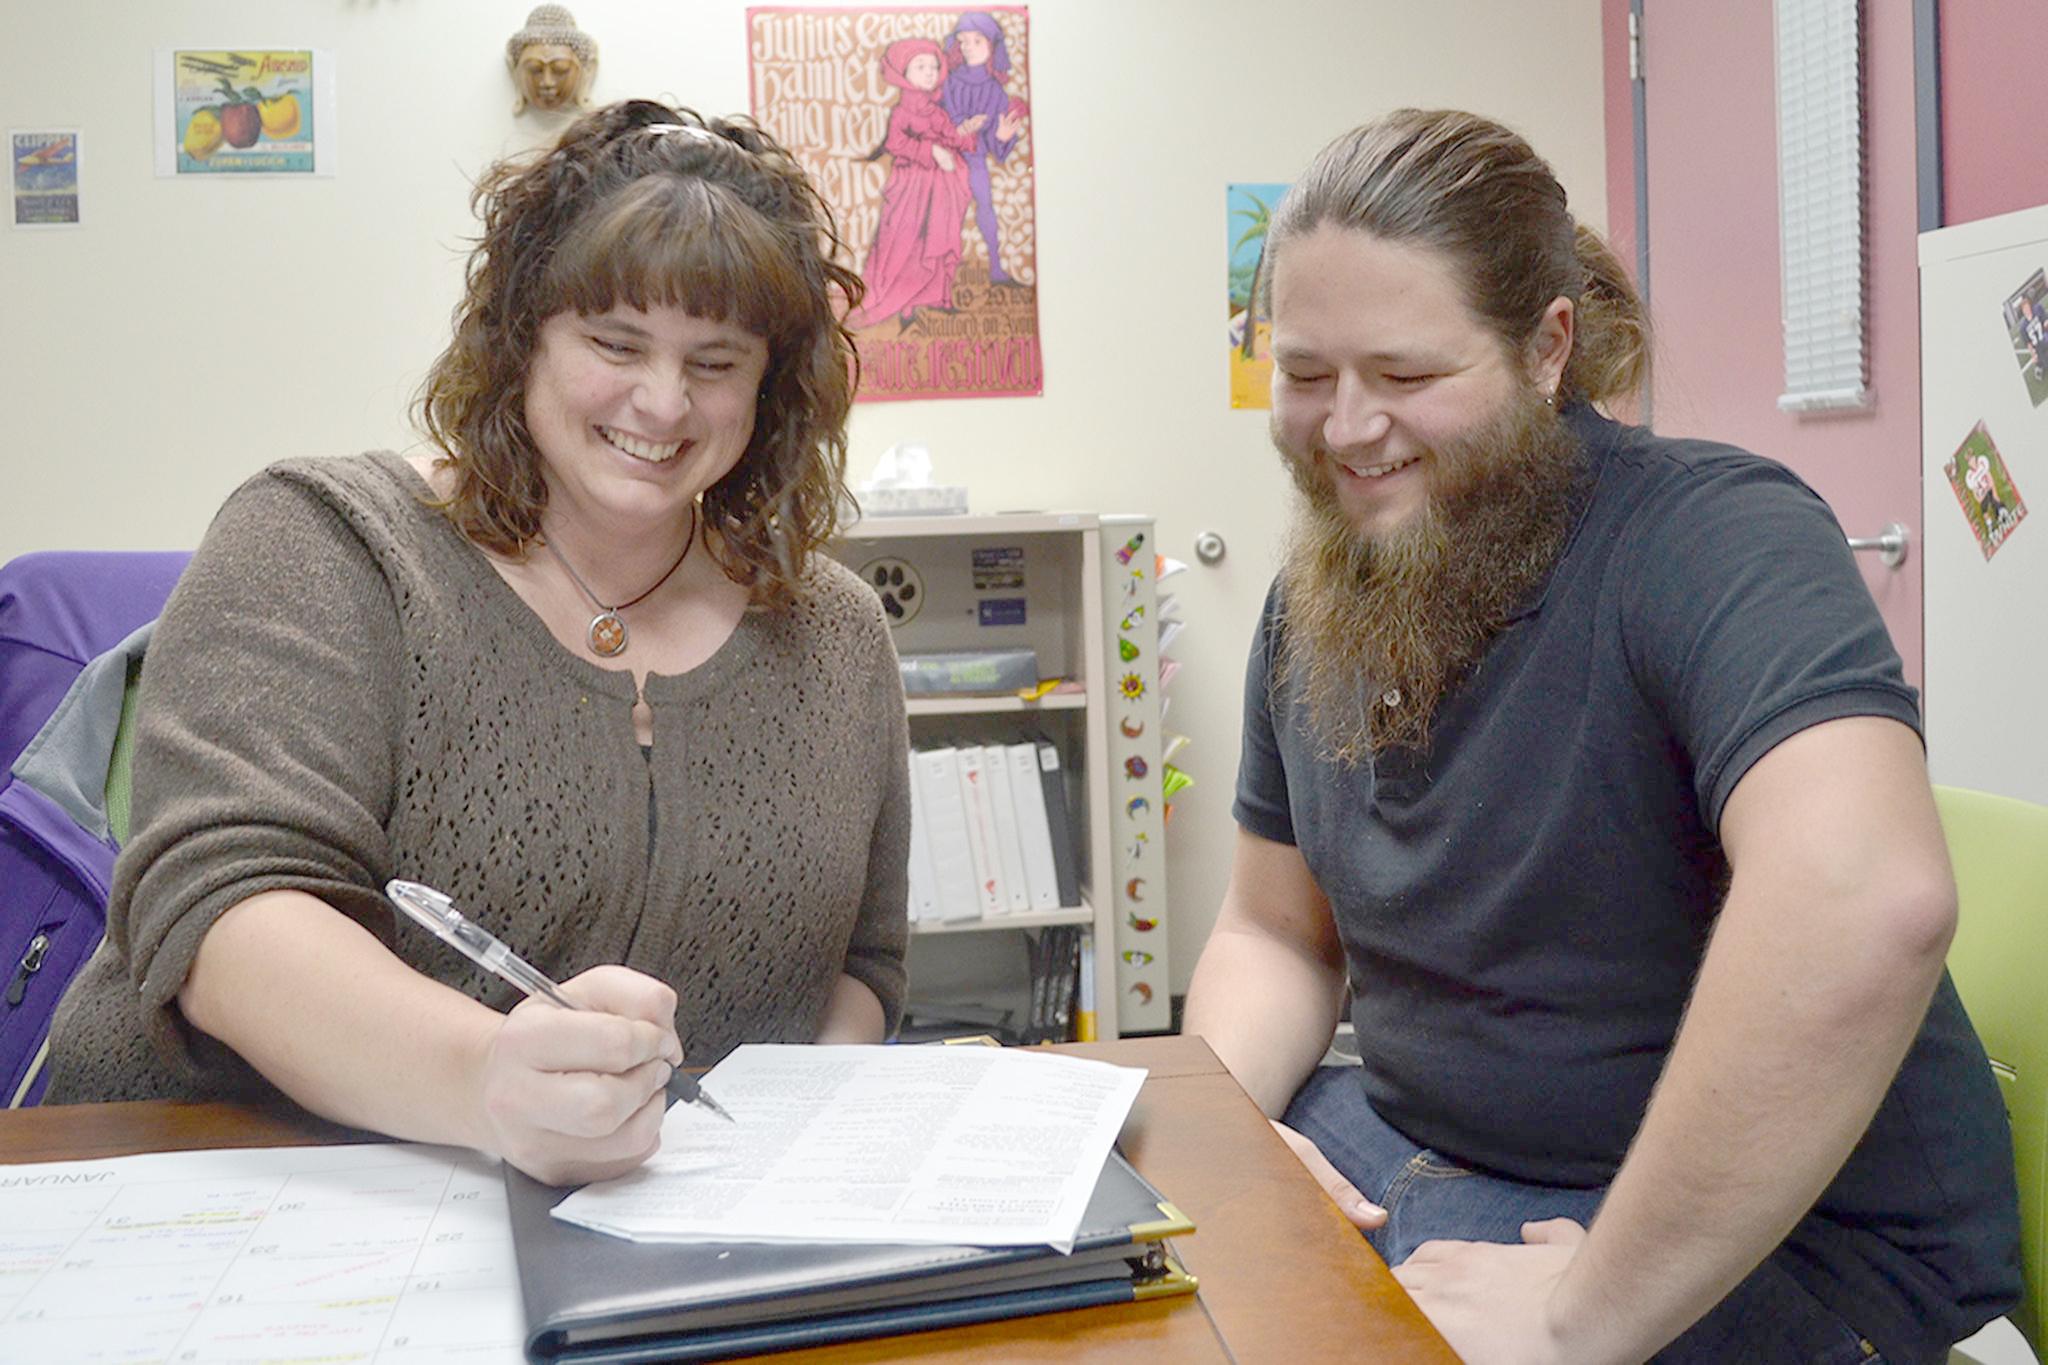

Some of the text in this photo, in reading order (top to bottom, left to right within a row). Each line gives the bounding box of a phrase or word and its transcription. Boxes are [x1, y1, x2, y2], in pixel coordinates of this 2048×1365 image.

[752, 13, 851, 62] Julius
[451, 1190, 481, 1201] 29
[434, 1231, 465, 1243] 22
